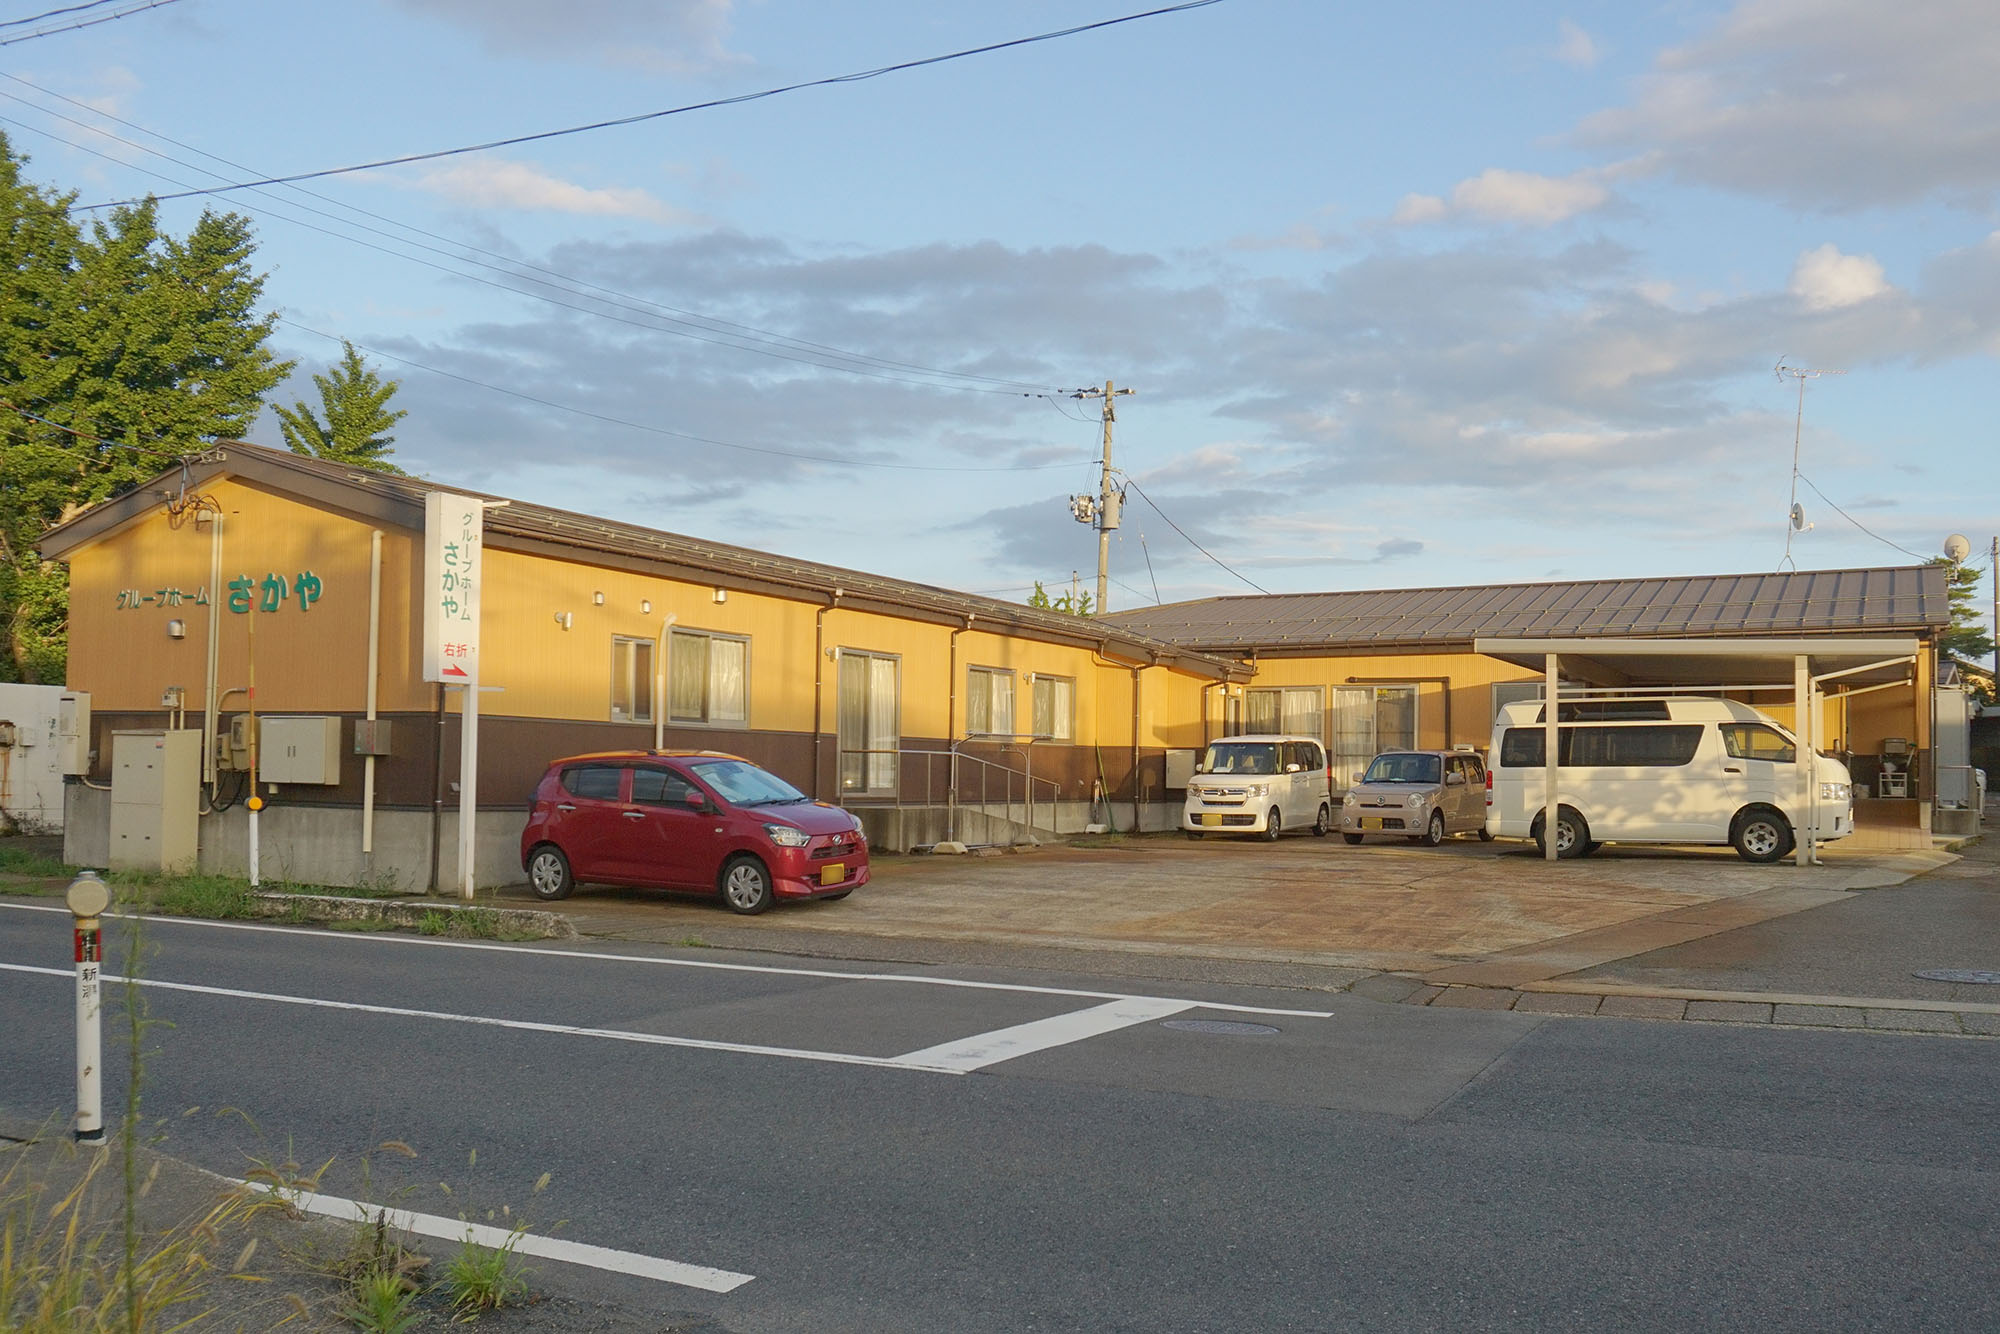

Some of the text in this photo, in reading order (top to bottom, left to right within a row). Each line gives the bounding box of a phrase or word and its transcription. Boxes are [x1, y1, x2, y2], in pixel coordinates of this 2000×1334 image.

[117, 571, 322, 613] グループホーム さかや
[441, 541, 460, 619] さかや
[461, 512, 474, 621] グループホーム
[444, 643, 467, 658] 右折
